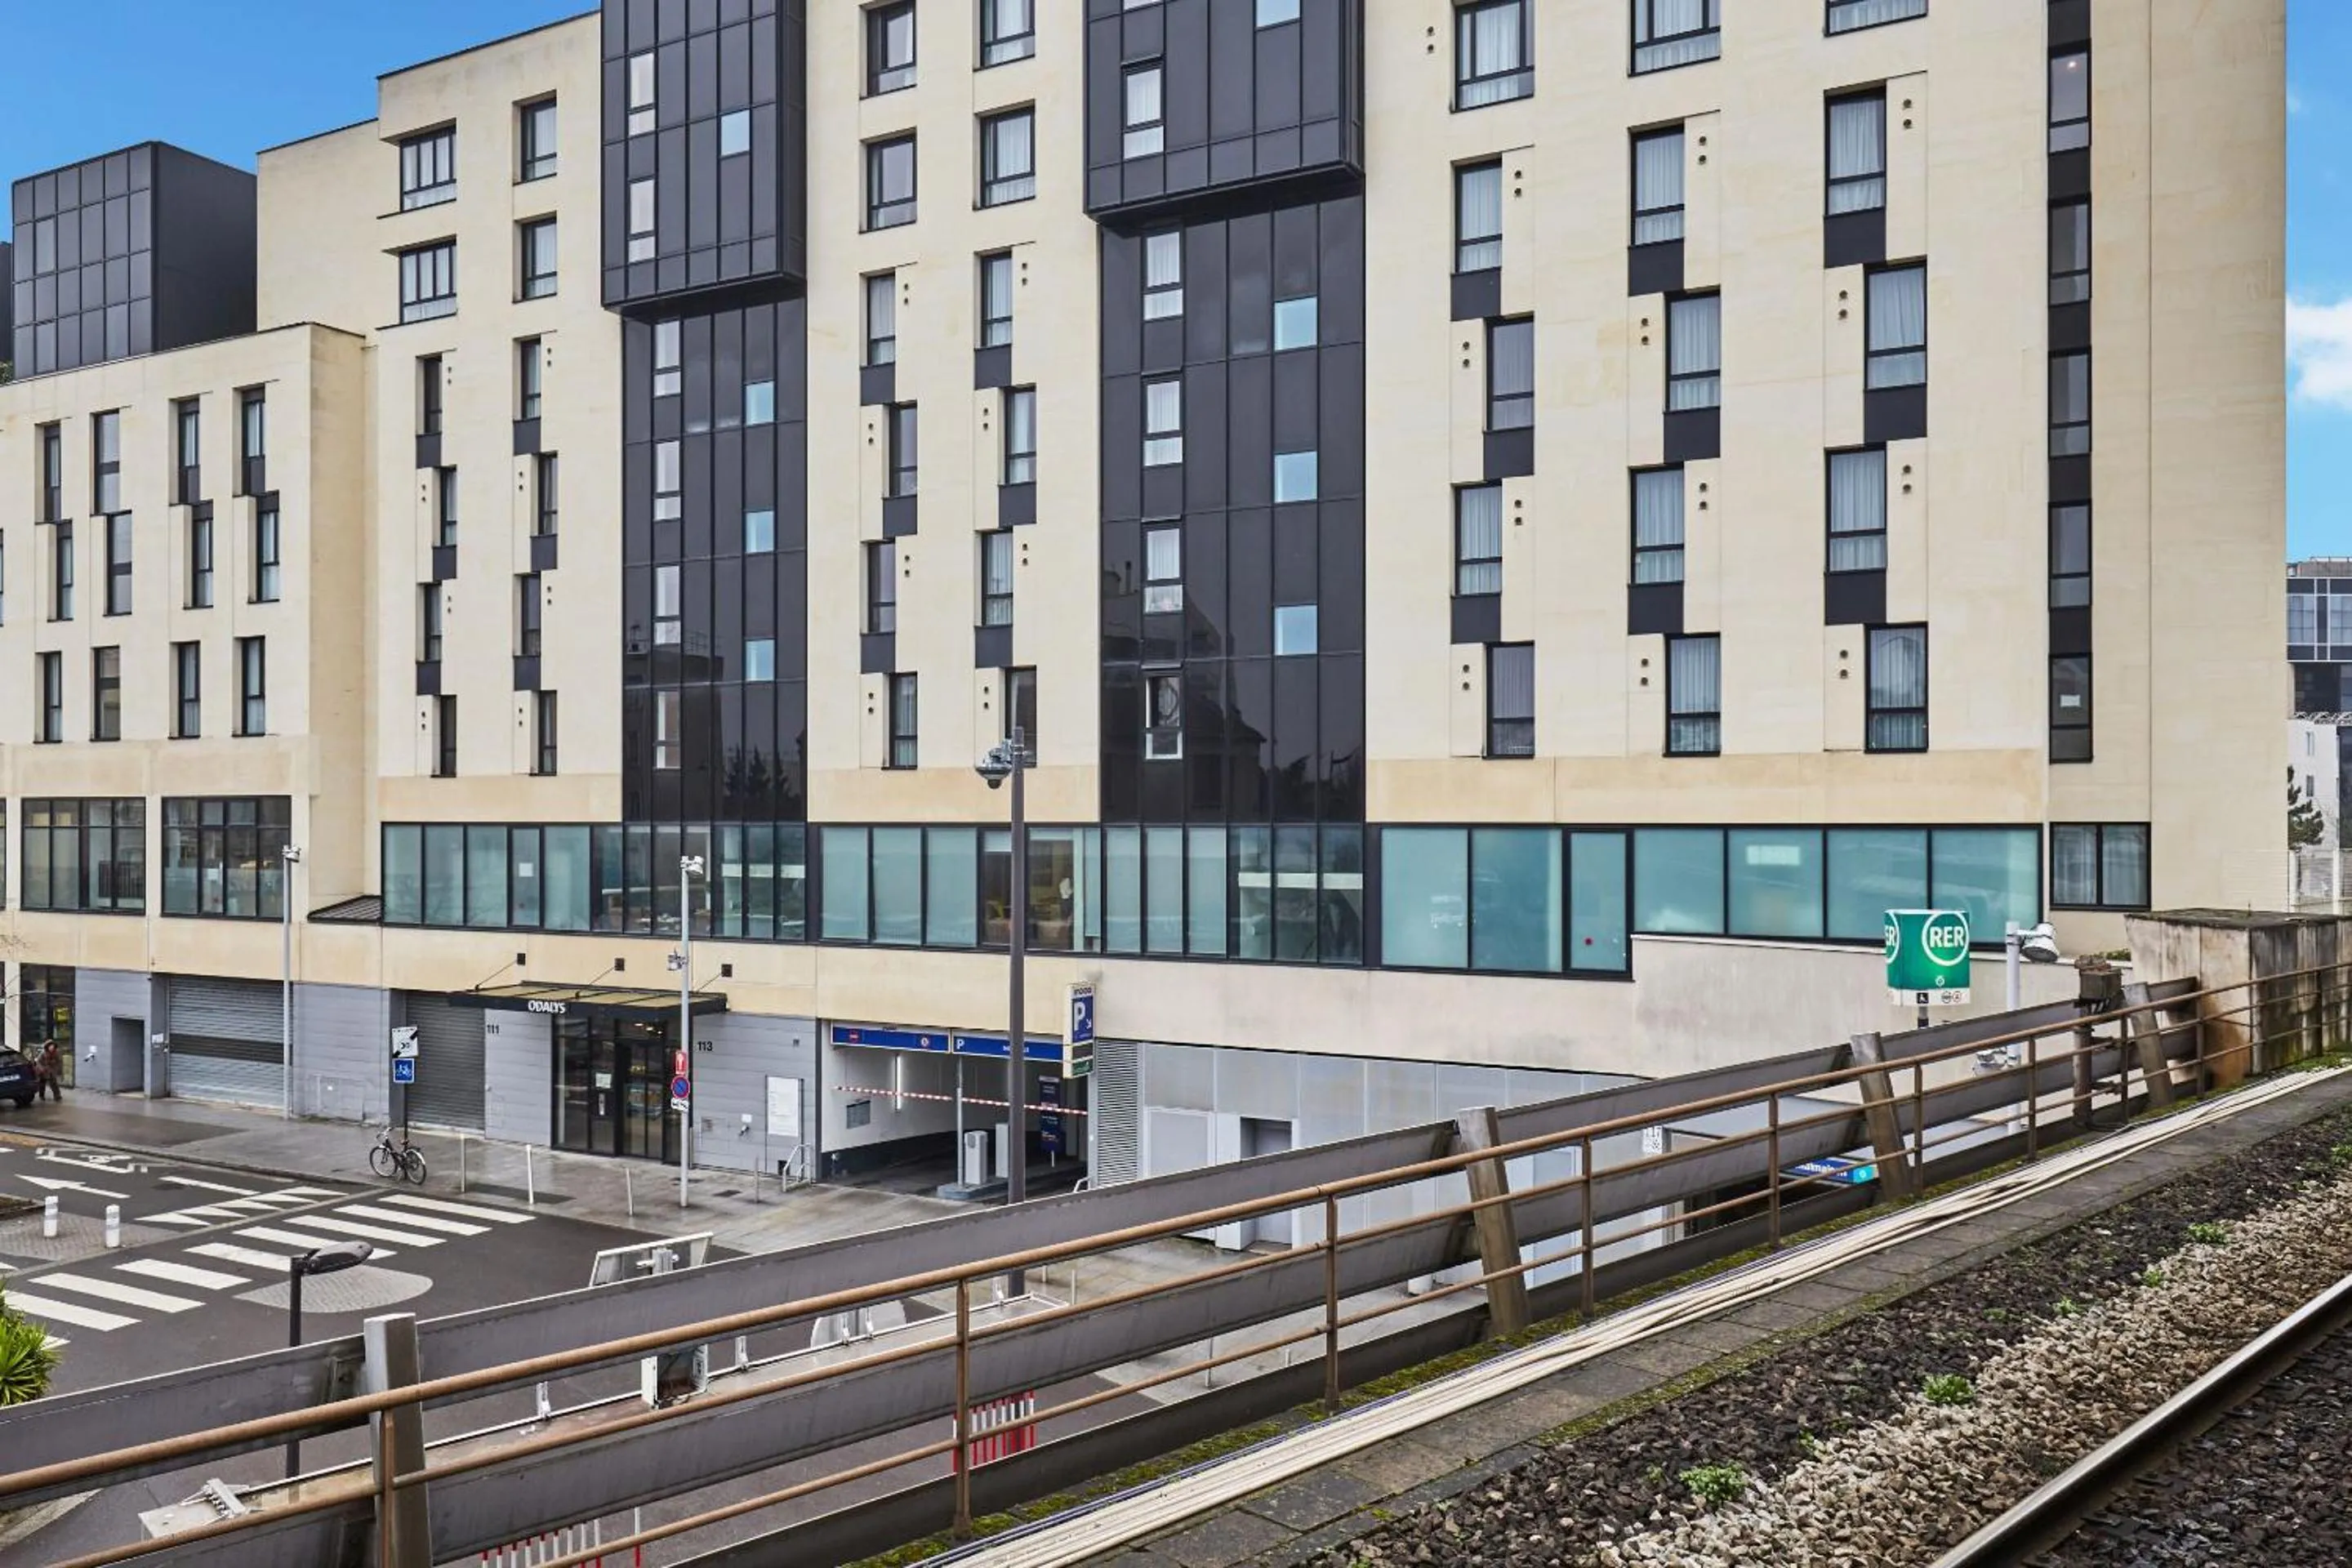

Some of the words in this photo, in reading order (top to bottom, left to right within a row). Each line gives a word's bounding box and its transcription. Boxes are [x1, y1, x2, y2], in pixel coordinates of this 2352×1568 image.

[1884, 924, 1895, 947] ER
[1929, 925, 1964, 948] RER
[528, 1000, 566, 1013] ODALYS
[1074, 1001, 1086, 1031] P
[487, 1024, 500, 1034] 111
[697, 1041, 713, 1051] 113
[956, 1039, 964, 1050] P
